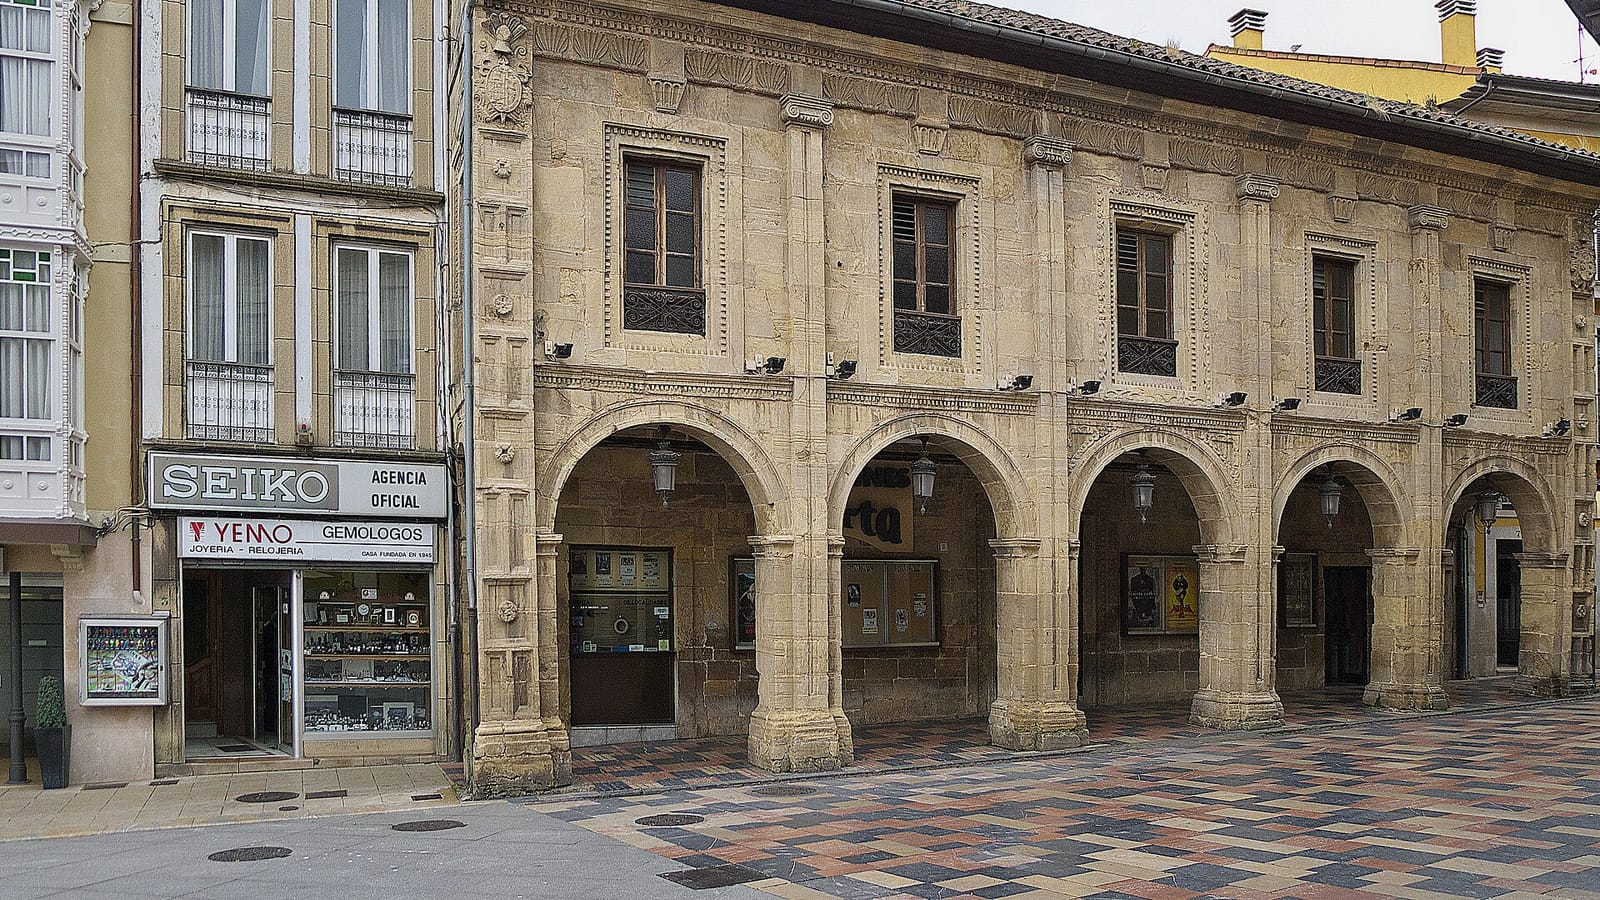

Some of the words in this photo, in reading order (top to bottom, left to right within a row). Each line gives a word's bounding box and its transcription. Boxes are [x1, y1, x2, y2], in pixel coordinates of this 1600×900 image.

[162, 463, 330, 504] SEIKO
[371, 470, 427, 486] AGENCIA
[855, 466, 912, 488] NES
[371, 493, 420, 509] OFICIAL
[322, 525, 423, 541] GEMOLOGOS
[189, 545, 234, 554] JOYERIA
[248, 546, 304, 555] RELOJERIA
